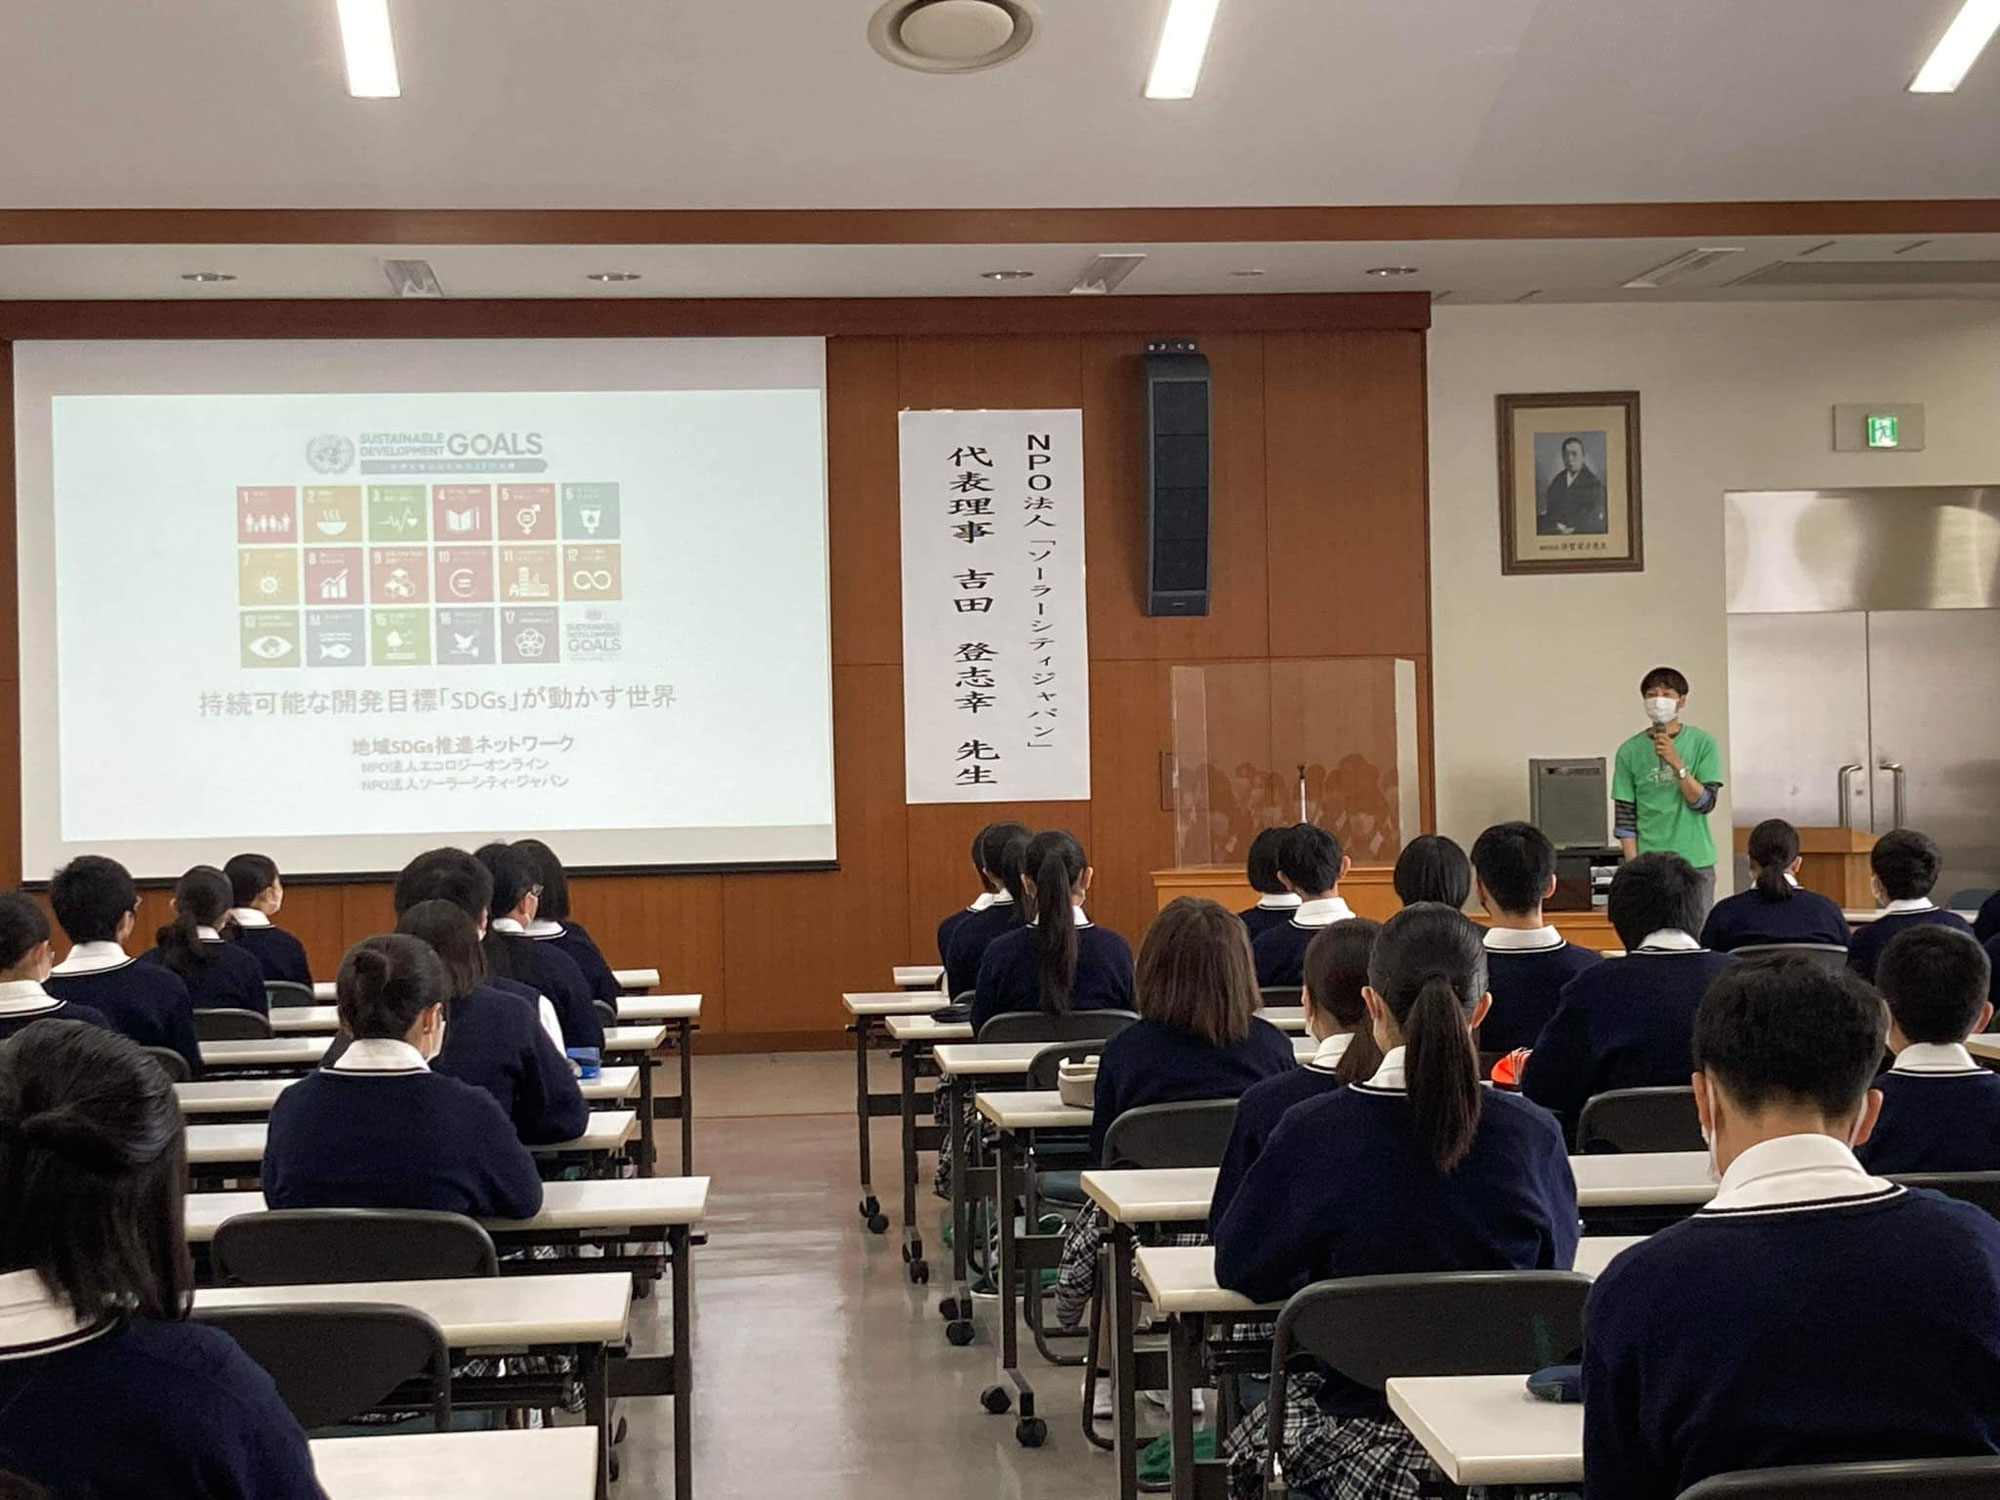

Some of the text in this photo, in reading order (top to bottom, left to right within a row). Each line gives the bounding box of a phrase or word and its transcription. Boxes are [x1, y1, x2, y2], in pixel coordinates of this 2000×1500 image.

[359, 432, 444, 444] SUSTAINABLE
[446, 432, 543, 457] GOALS
[359, 445, 444, 457] DEVELOPMENT
[1023, 433, 1058, 748] NPO法人「ソーラーシティジャパン」
[947, 445, 1000, 786] 代表理事 吉田 登志幸 先生
[568, 638, 621, 652] GOALS
[199, 684, 677, 717] 持続可能な開発目標「SDGs」が動かす世界
[352, 734, 575, 756] 地域SDGs推進ネットワーク
[360, 756, 551, 774] NPO法人エコロジーオンライン
